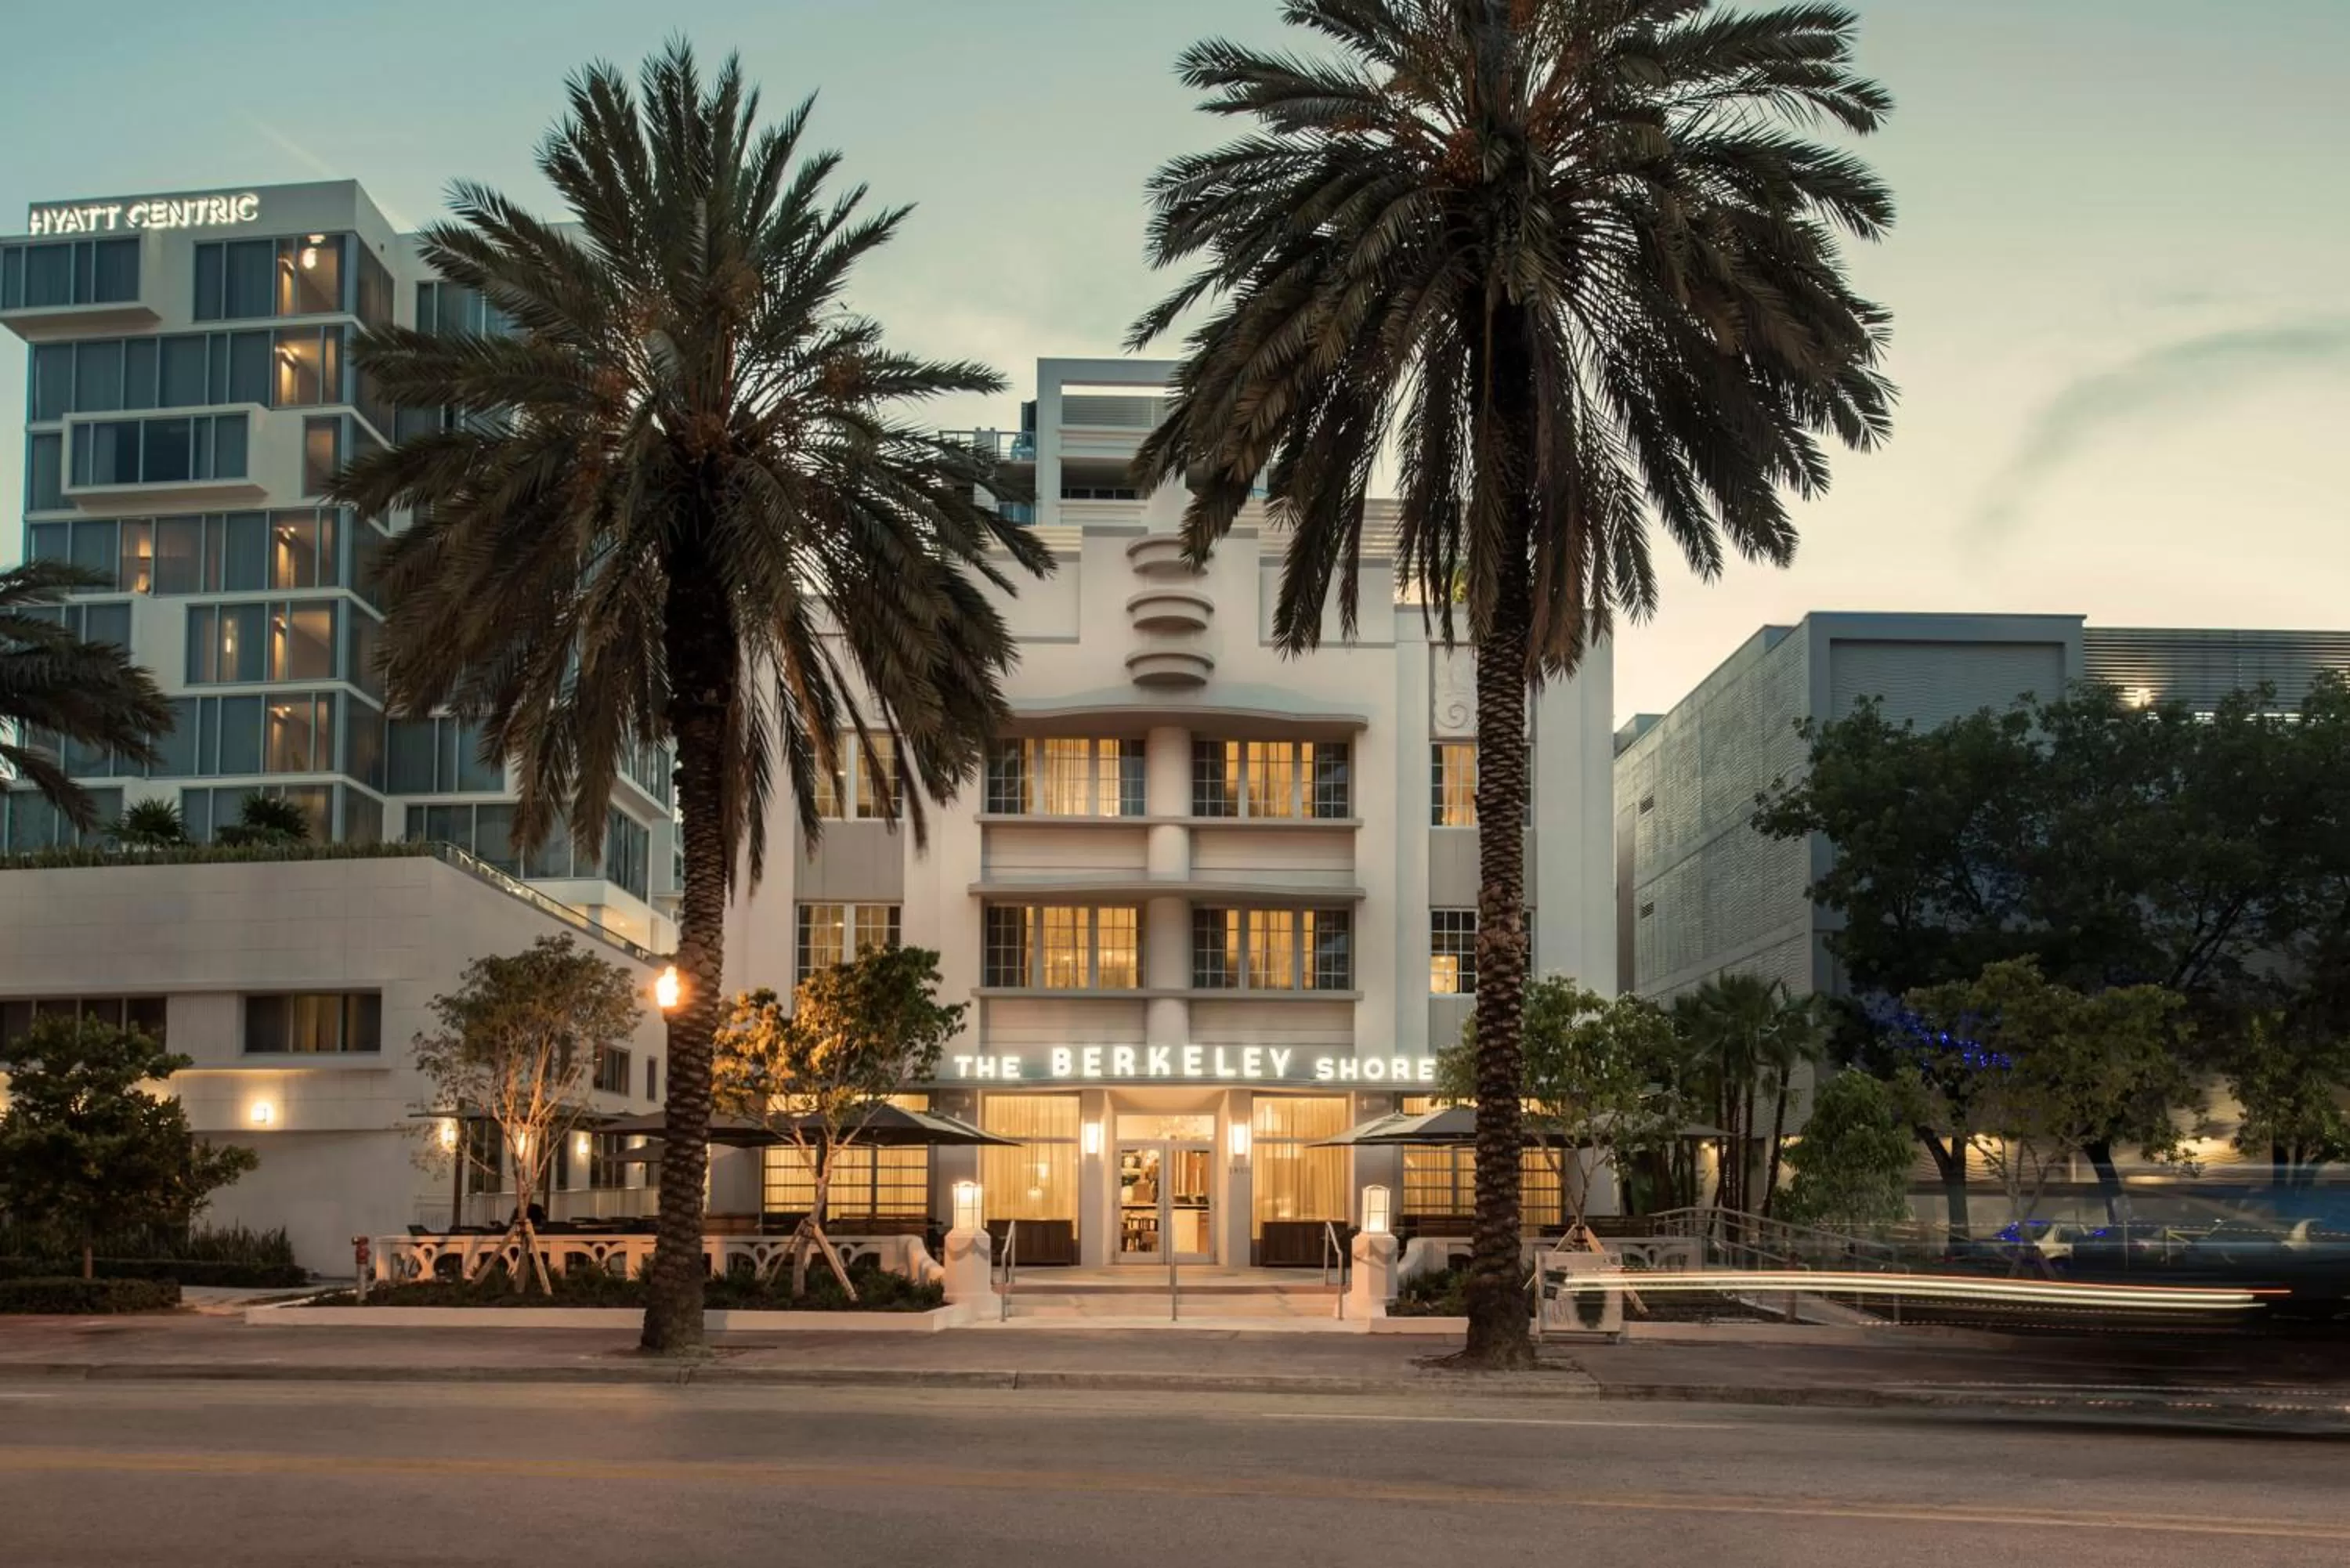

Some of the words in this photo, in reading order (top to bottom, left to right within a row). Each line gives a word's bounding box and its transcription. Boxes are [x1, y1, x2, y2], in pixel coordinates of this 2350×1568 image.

[29, 203, 121, 236] HYATT
[125, 192, 259, 229] CENTRIC
[954, 1056, 1021, 1079] THE
[1052, 1046, 1292, 1078] BERKELEY
[1315, 1057, 1437, 1081] SHORE
